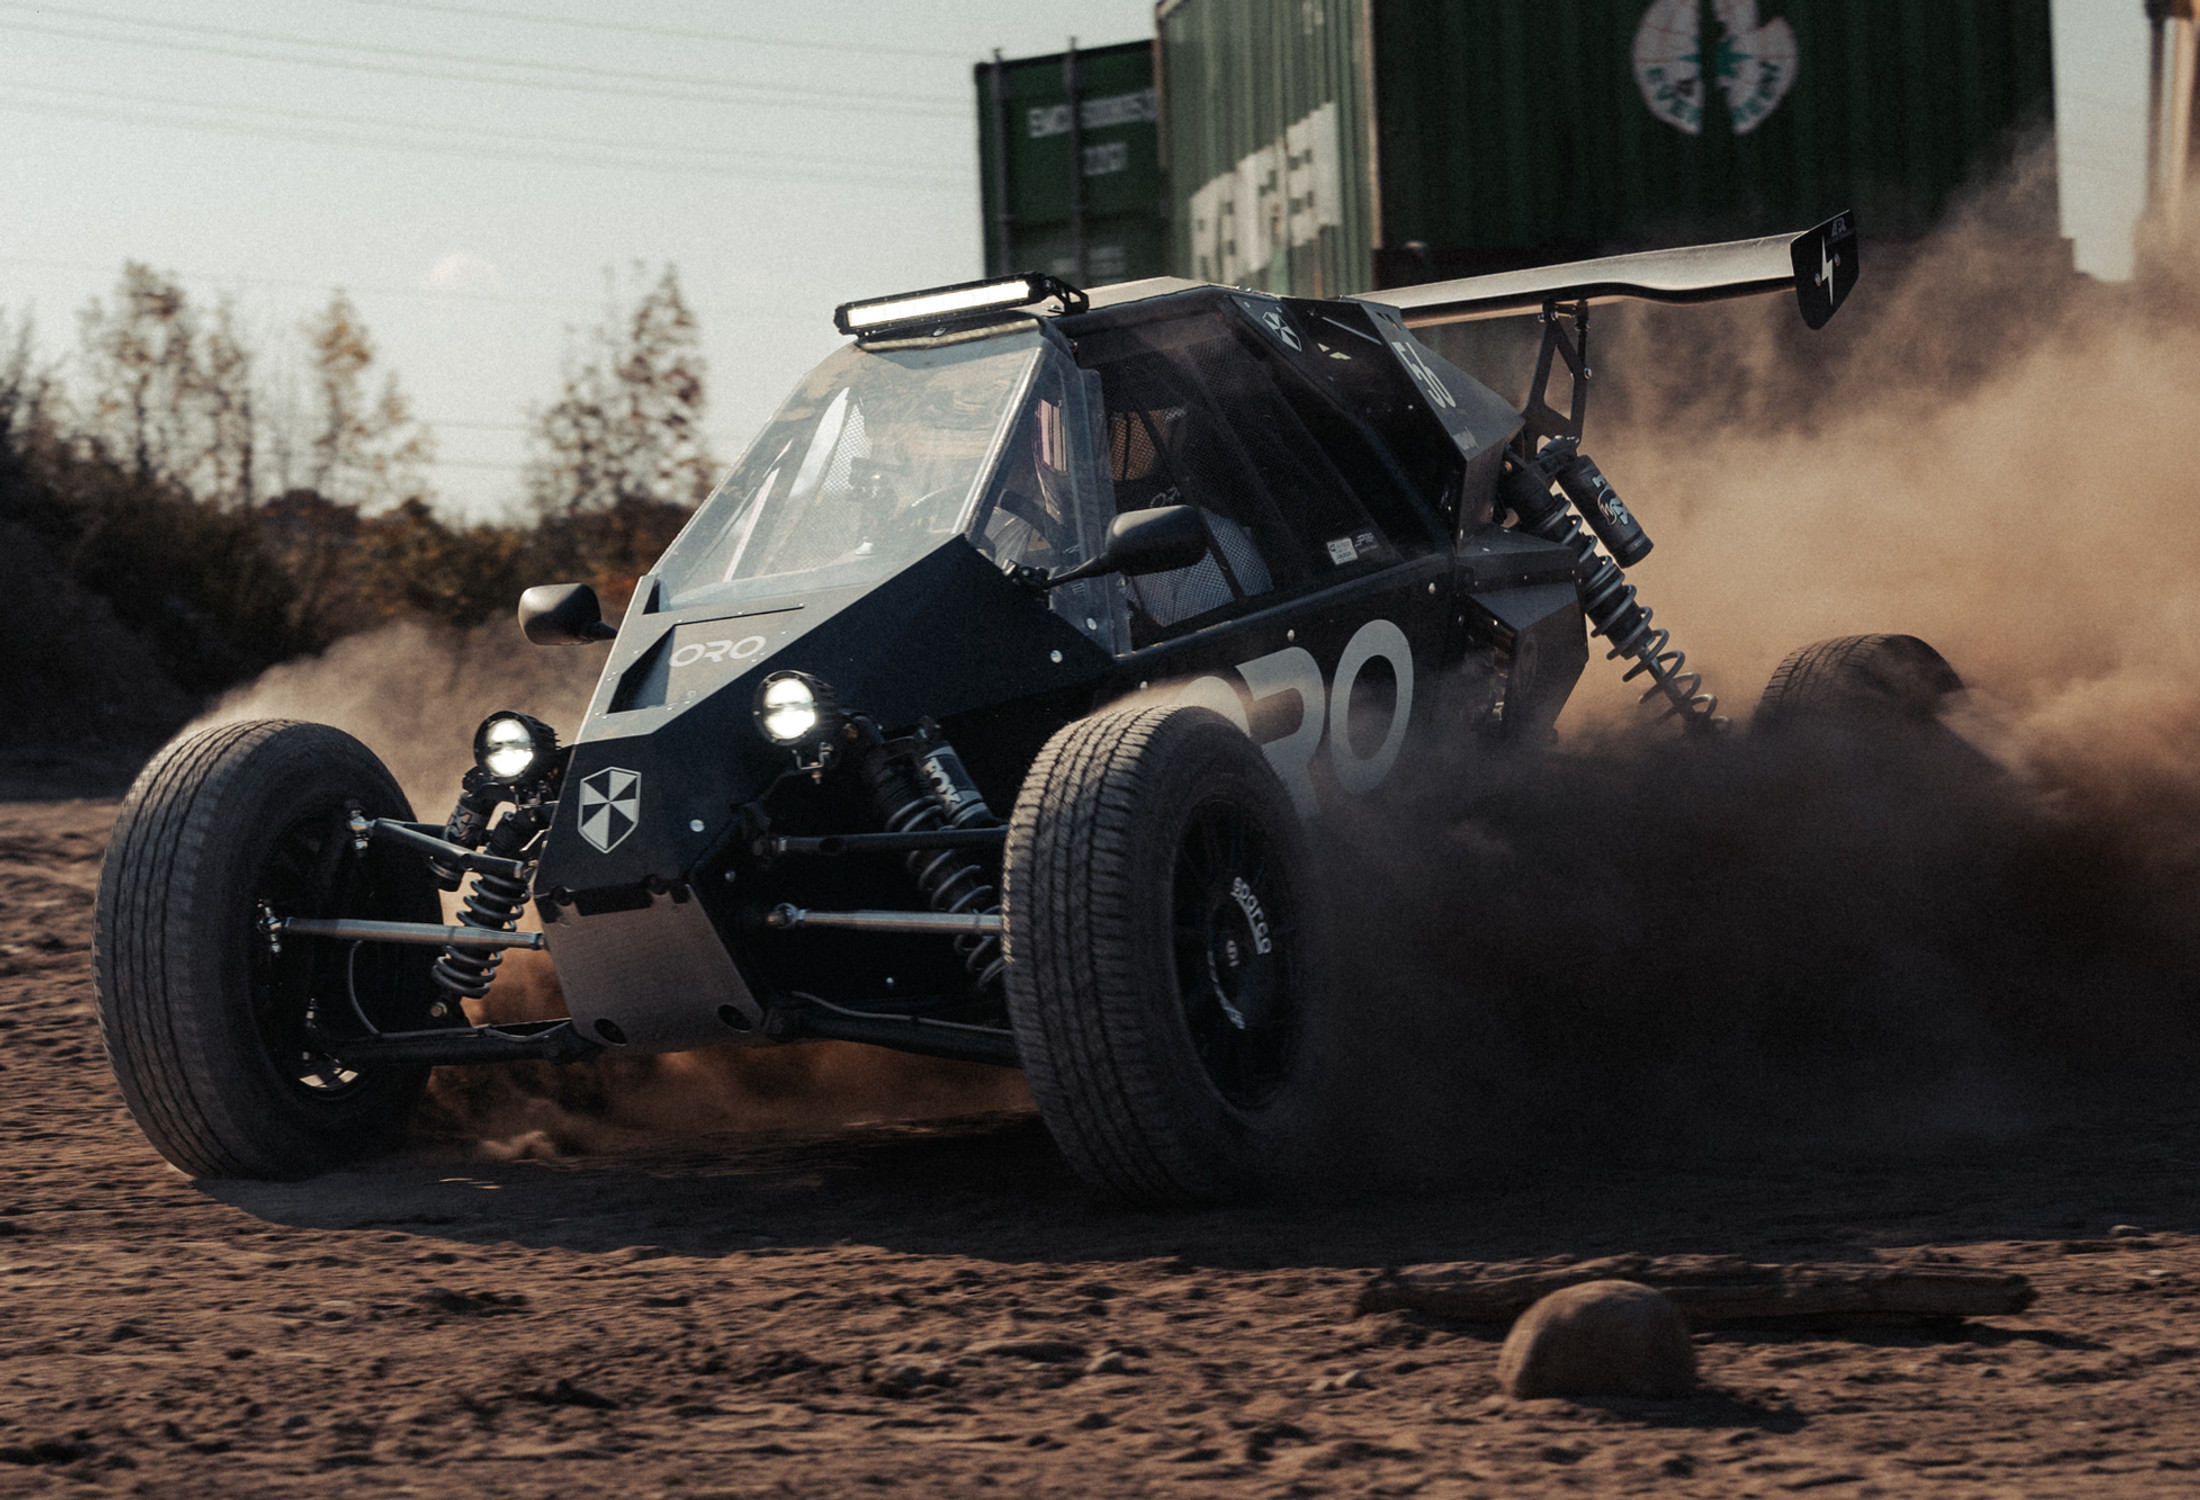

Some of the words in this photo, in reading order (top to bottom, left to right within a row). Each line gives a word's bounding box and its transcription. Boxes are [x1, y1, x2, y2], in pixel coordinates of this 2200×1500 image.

[669, 635, 767, 668] ORO
[1176, 619, 1414, 820] RO
[1230, 876, 1273, 955] sparco
